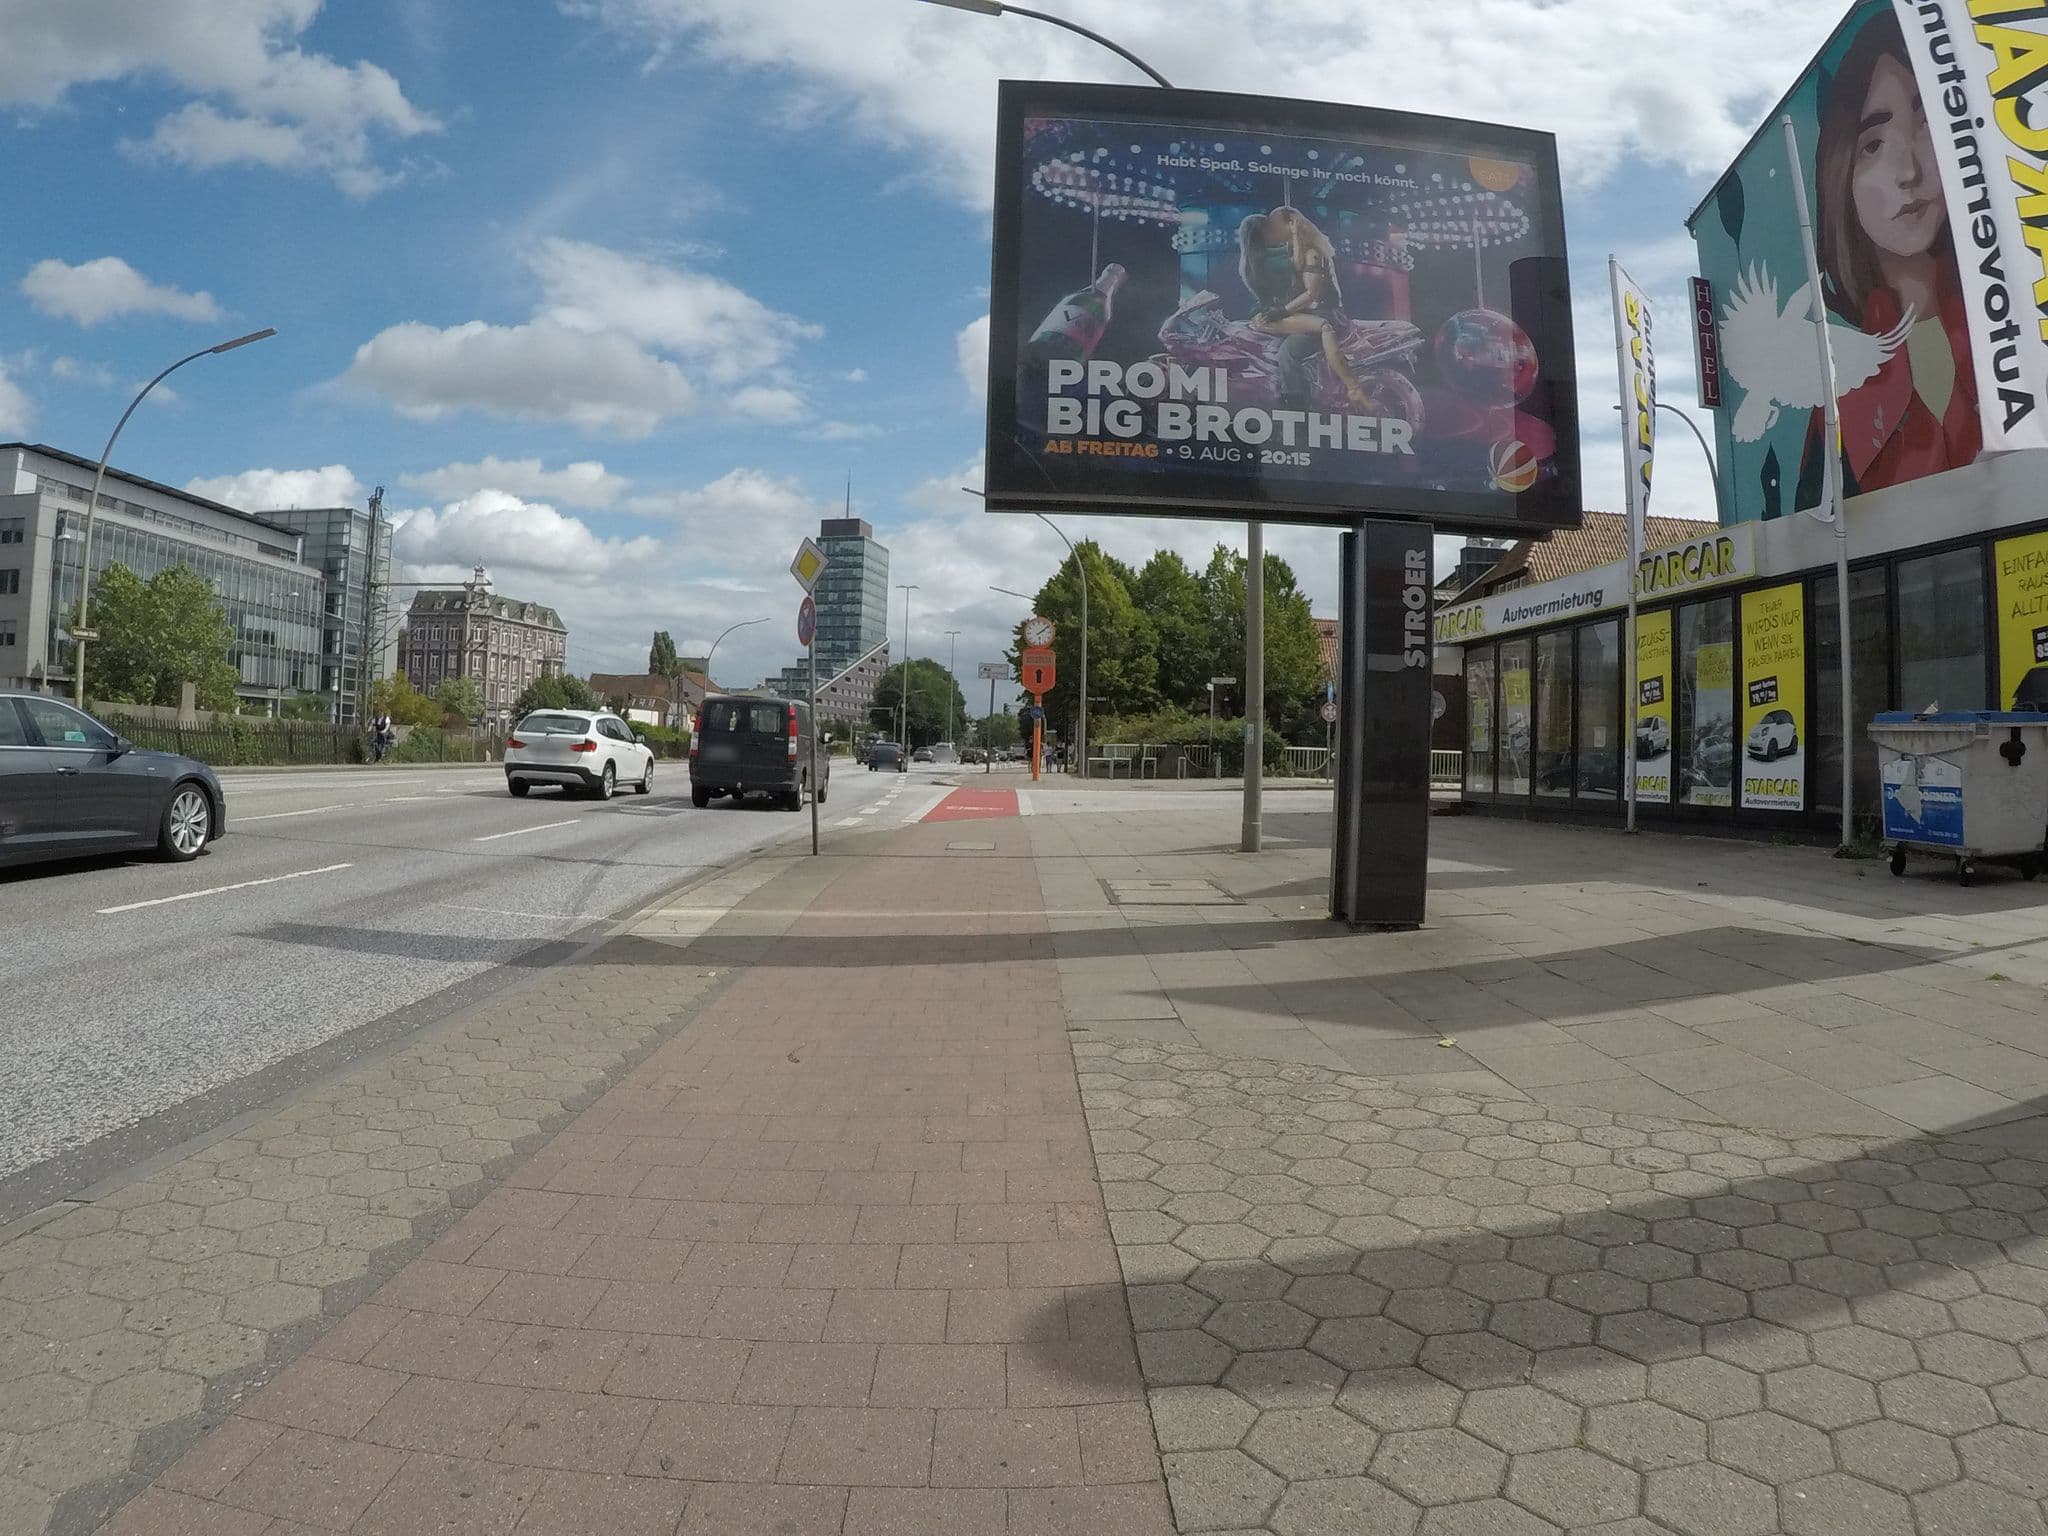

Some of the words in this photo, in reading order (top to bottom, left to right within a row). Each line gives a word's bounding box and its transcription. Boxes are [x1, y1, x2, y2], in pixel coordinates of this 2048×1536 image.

[1157, 154, 1196, 168] Habt
[1200, 157, 1244, 173] Spaß.
[1248, 161, 1309, 179] Solange
[1312, 167, 1333, 179] ihr
[1335, 172, 1370, 184] noch
[1374, 174, 1419, 189] könnt.
[1695, 285, 1718, 400] HOTEL
[1048, 359, 1228, 403] PROMI
[1047, 397, 1142, 438] BIG
[1157, 402, 1415, 455] BROTHER
[1044, 439, 1073, 454] AB
[1077, 440, 1159, 458] FREITAG
[1179, 445, 1195, 460] 9.
[1199, 447, 1241, 462] AUG
[1260, 449, 1311, 467] 20:15
[1402, 549, 1427, 669] STRÖER
[1433, 606, 1485, 641] TARCAR
[1502, 588, 1603, 625] Autovermietung
[2011, 595, 2048, 620] ALLT
[1637, 628, 1670, 649] ZUGS-
[1753, 634, 1779, 653] WENN
[1635, 775, 1669, 791] ARCAR
[1745, 778, 1800, 797] STARCAR
[1744, 799, 1800, 809] Autovermietung
